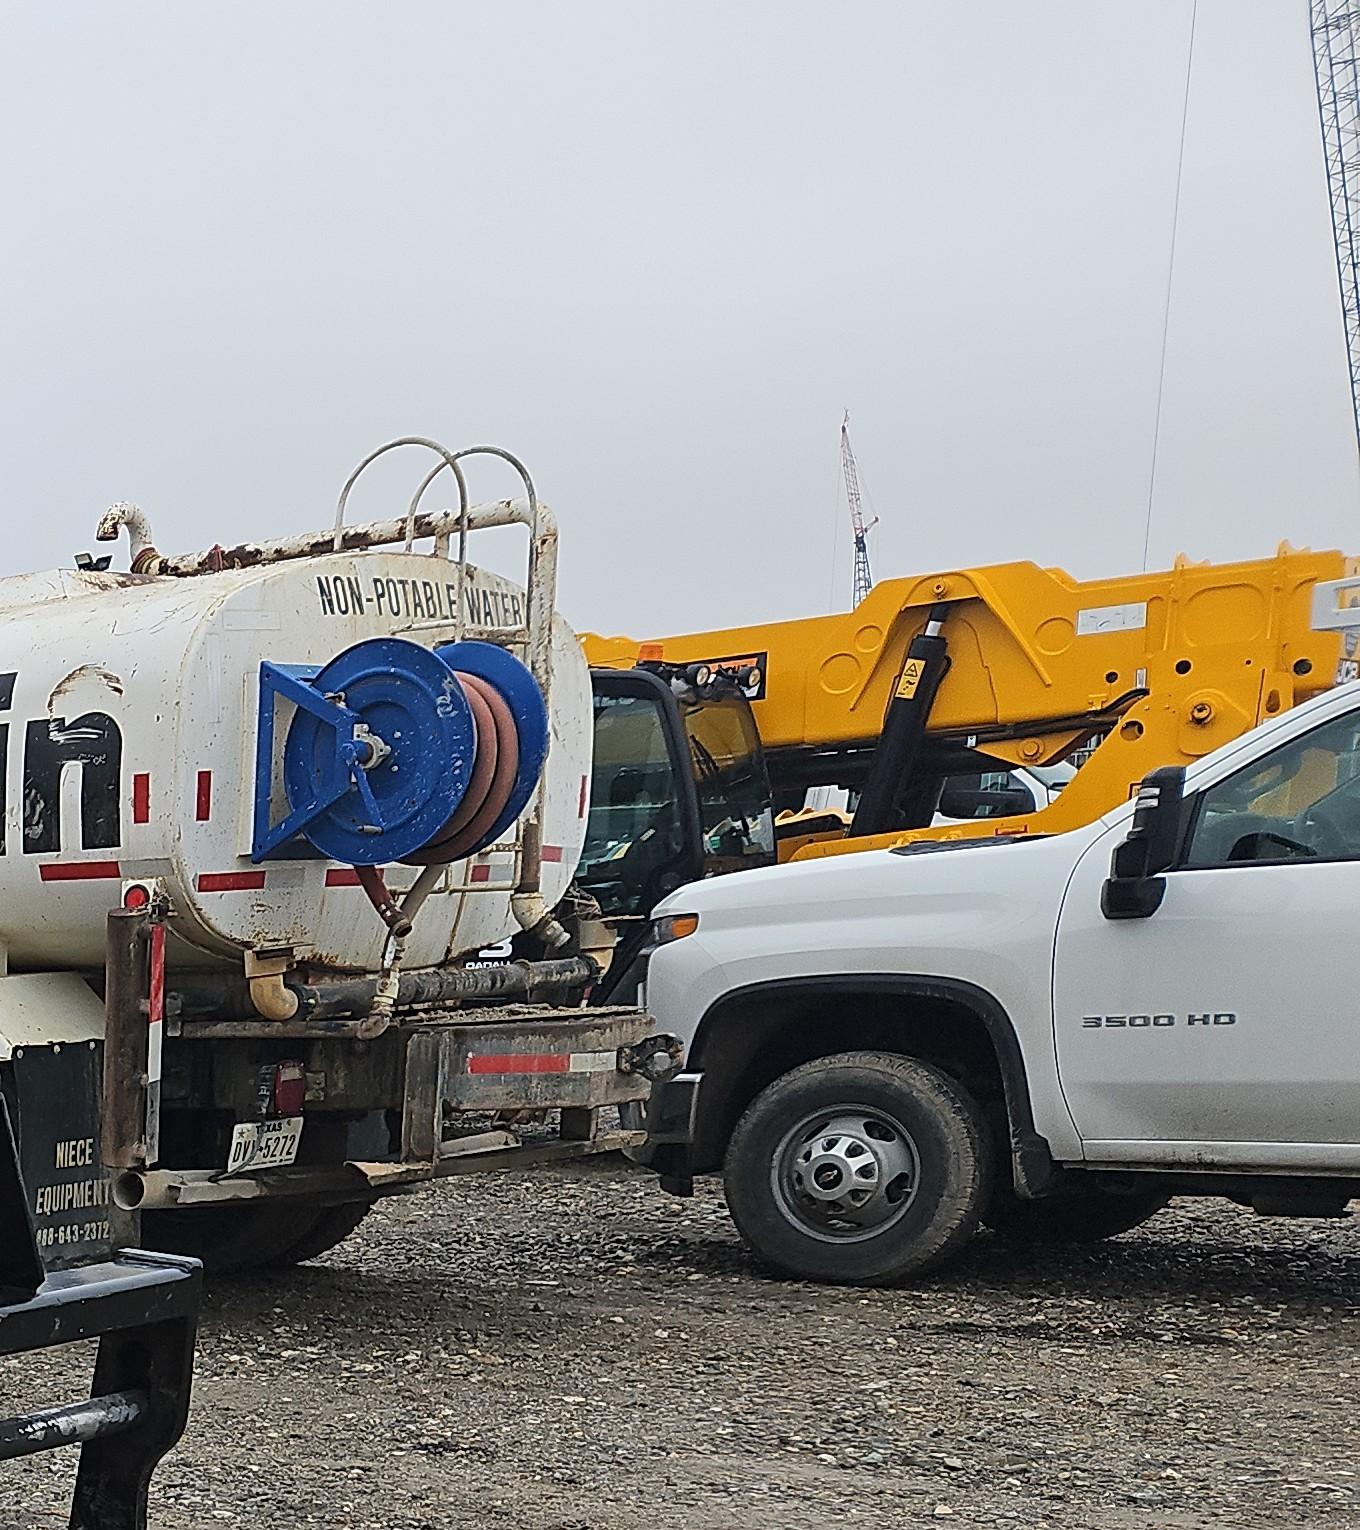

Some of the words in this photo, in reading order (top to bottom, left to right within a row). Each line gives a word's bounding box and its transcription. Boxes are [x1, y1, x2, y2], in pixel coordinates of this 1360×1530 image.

[316, 576, 457, 619] NON-POTABLE
[465, 586, 523, 628] WATER
[1082, 1015, 1175, 1028] 3500
[1187, 1013, 1236, 1026] HD
[256, 1122, 282, 1134] TXAS
[55, 1138, 94, 1169] NIECE
[35, 1179, 110, 1216] EQUIPMENT
